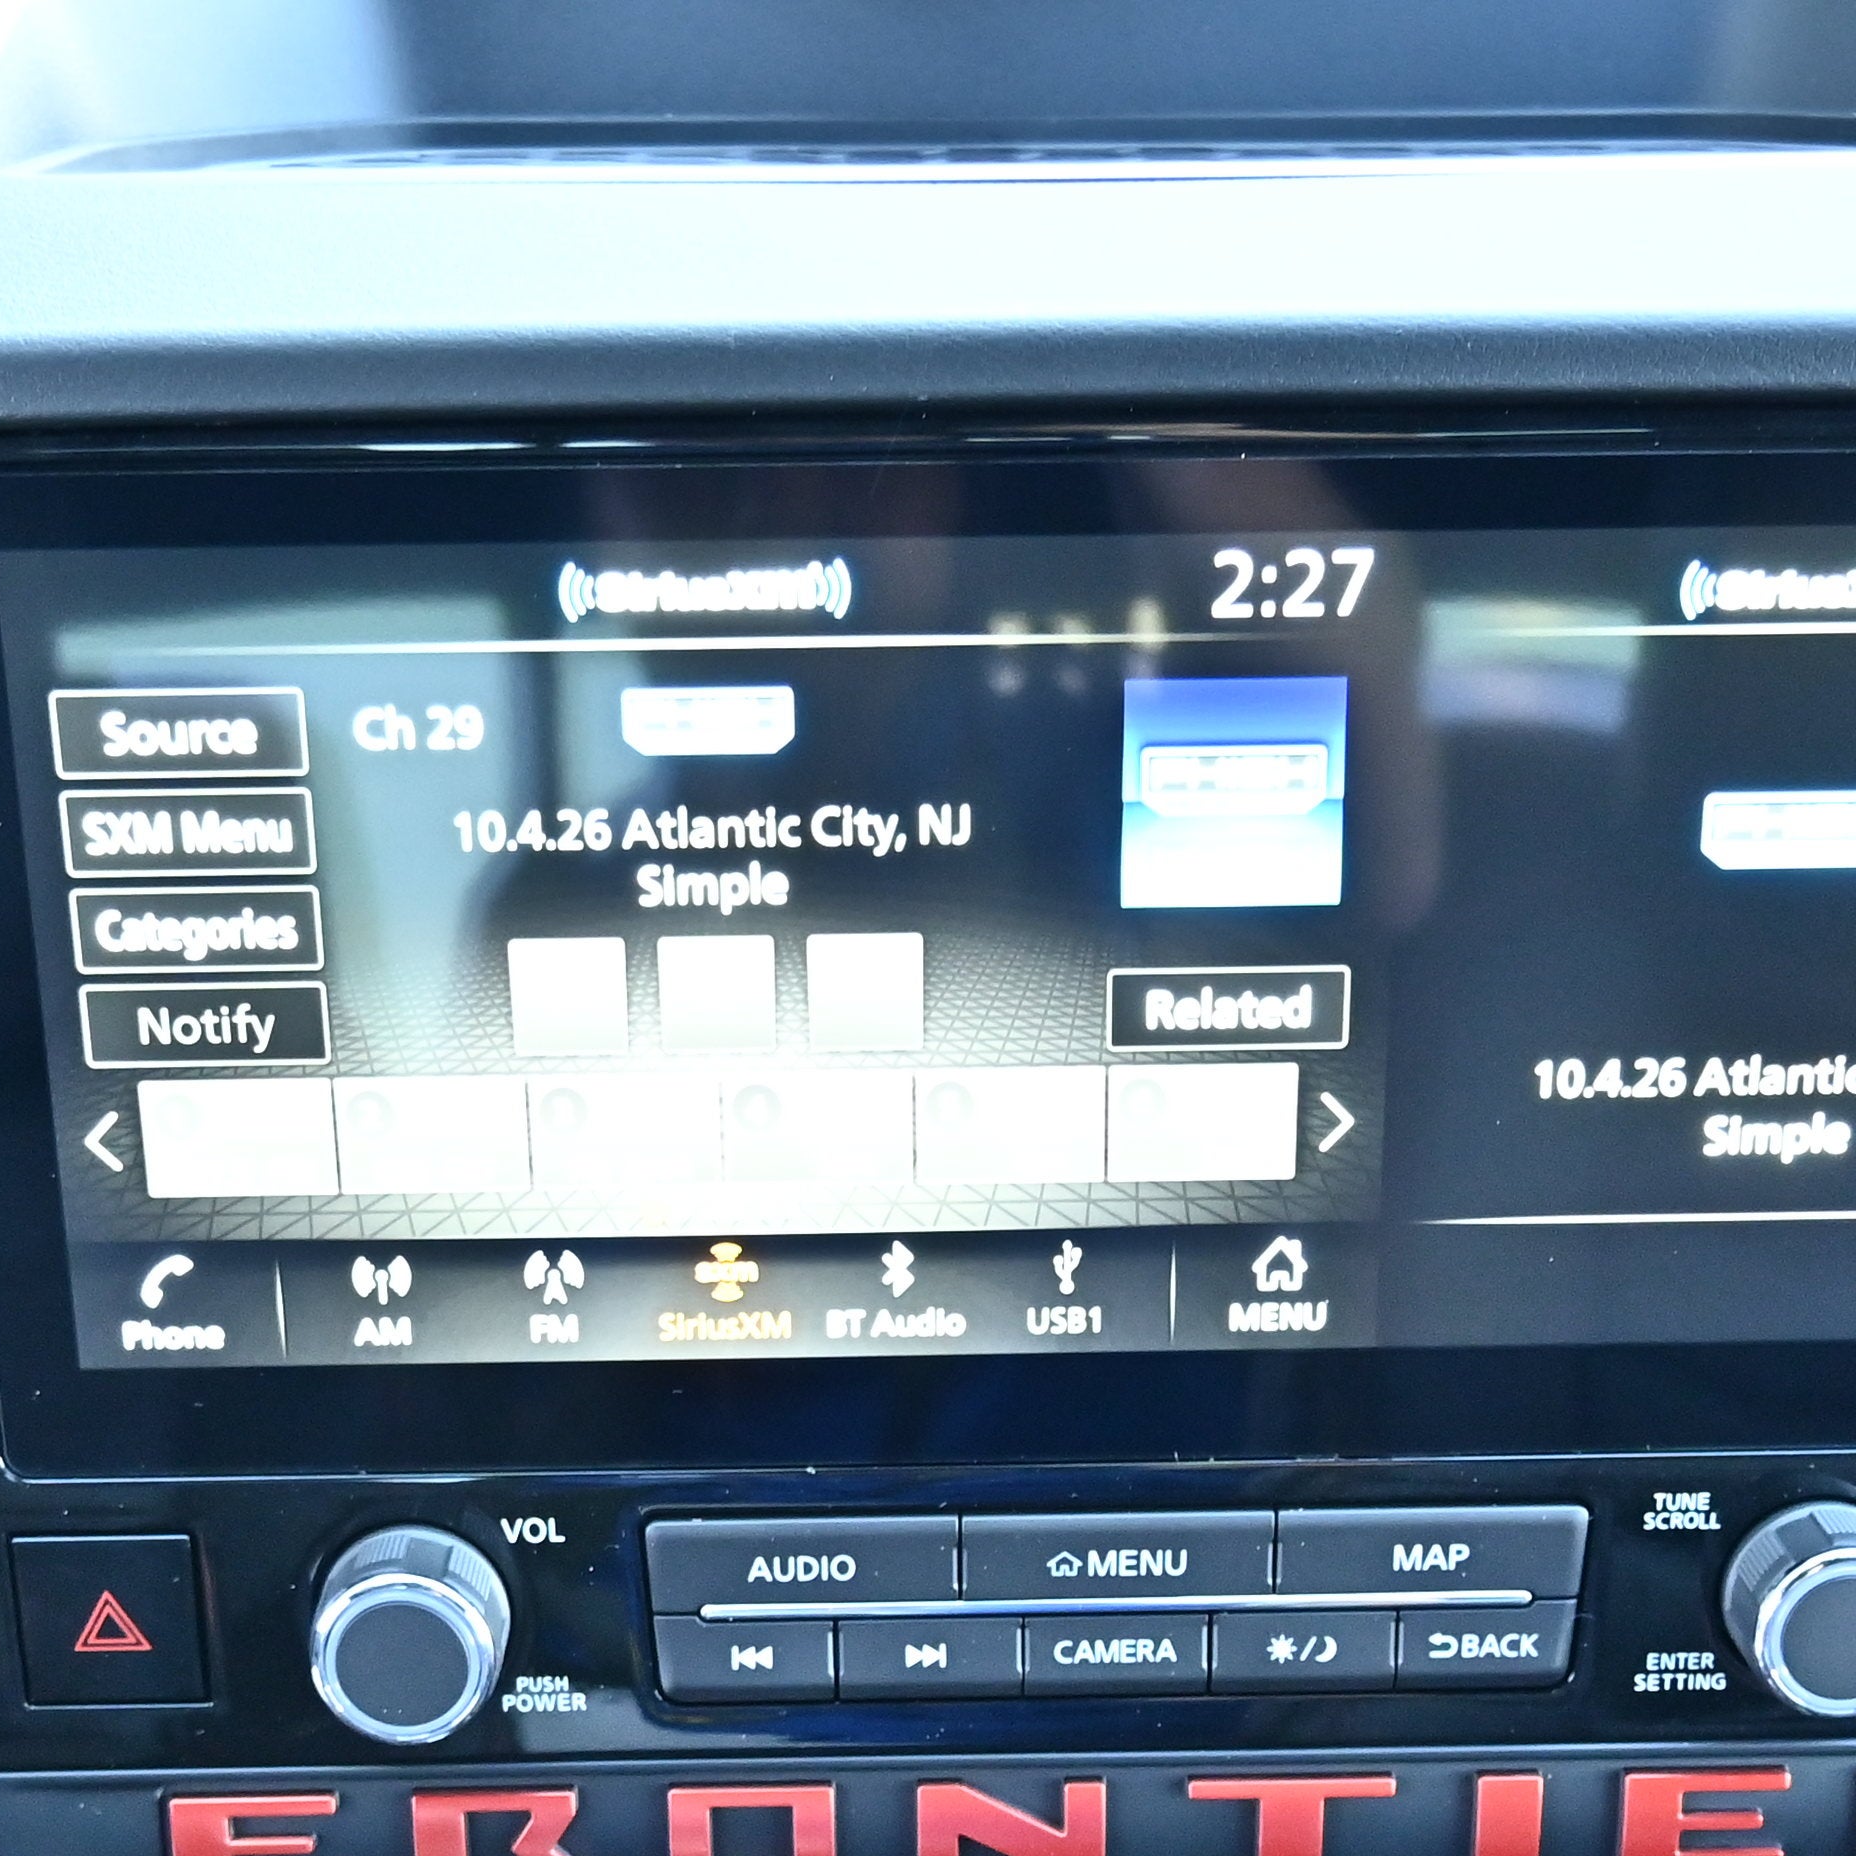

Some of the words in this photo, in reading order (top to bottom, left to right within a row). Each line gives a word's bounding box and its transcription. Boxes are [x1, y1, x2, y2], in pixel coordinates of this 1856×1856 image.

[1211, 548, 1374, 619] 2:27
[99, 710, 259, 756] Source
[352, 707, 416, 751] Ch
[426, 704, 484, 751] 29
[82, 812, 172, 857] SXM
[179, 808, 293, 854] Menu
[453, 808, 613, 853] 10.4.26
[621, 805, 801, 850] Atlantic
[810, 804, 907, 857] City,
[918, 803, 971, 847] NJ
[636, 861, 790, 915] Simple
[94, 908, 299, 960] Categories
[1144, 985, 1312, 1031] Related
[136, 1003, 276, 1053] Notify
[1533, 1057, 1687, 1100] 10.4.26
[1702, 1111, 1852, 1163] Simple
[354, 1315, 412, 1347] AM
[529, 1314, 580, 1344] FM
[657, 1311, 792, 1342] SiriusXM
[825, 1310, 867, 1339] BT
[871, 1307, 967, 1338] Audio
[1026, 1306, 1103, 1336] USB1
[1228, 1302, 1325, 1333] MENU
[121, 1320, 226, 1351] Phone
[1653, 1491, 1711, 1511] TUNE
[500, 1517, 566, 1544] VOL
[1642, 1511, 1721, 1531] SCROLL
[747, 1553, 857, 1583] AUDIO
[1087, 1549, 1188, 1579] MENU
[1392, 1543, 1470, 1572] MAP
[1053, 1639, 1178, 1666] CAMERA
[1461, 1632, 1538, 1660] BACK
[1646, 1652, 1715, 1671] ENTER
[516, 1676, 569, 1693] PUSH
[1633, 1672, 1727, 1692] SETTING
[502, 1692, 587, 1713] POWER
